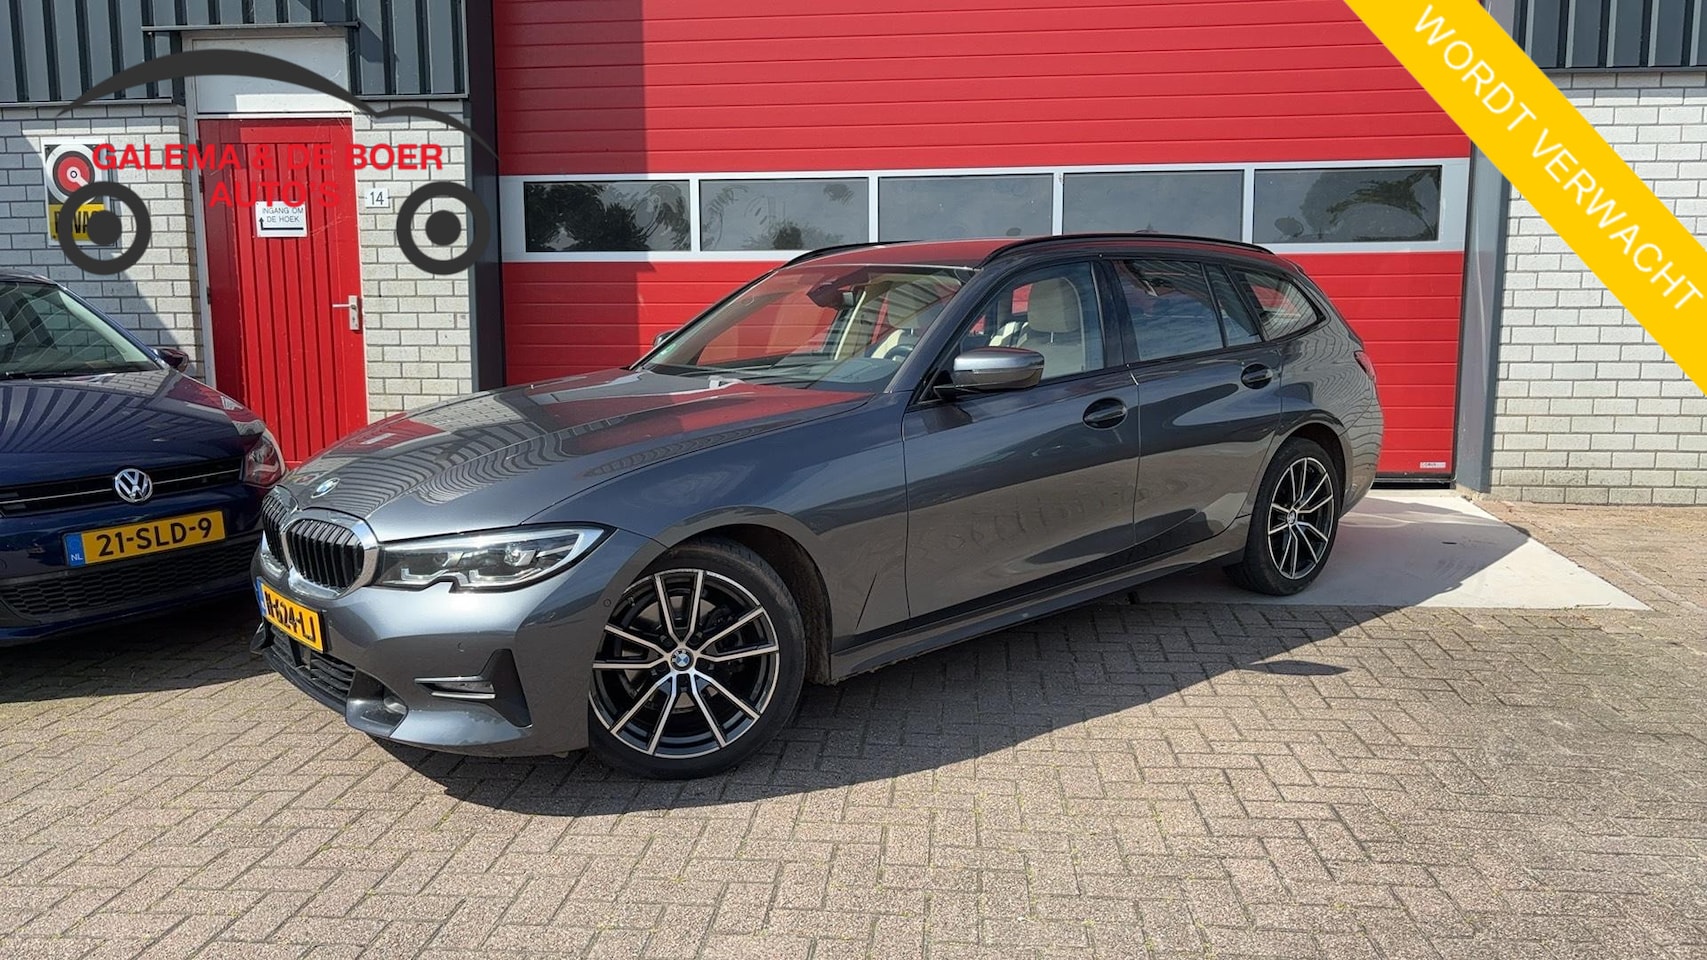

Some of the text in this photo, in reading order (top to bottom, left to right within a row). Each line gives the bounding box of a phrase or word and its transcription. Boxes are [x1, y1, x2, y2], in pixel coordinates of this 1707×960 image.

[369, 191, 385, 206] 14
[262, 206, 304, 215] INGANG OM
[266, 215, 300, 224] DE HOEK
[70, 517, 212, 562] NL 21-SLD-9
